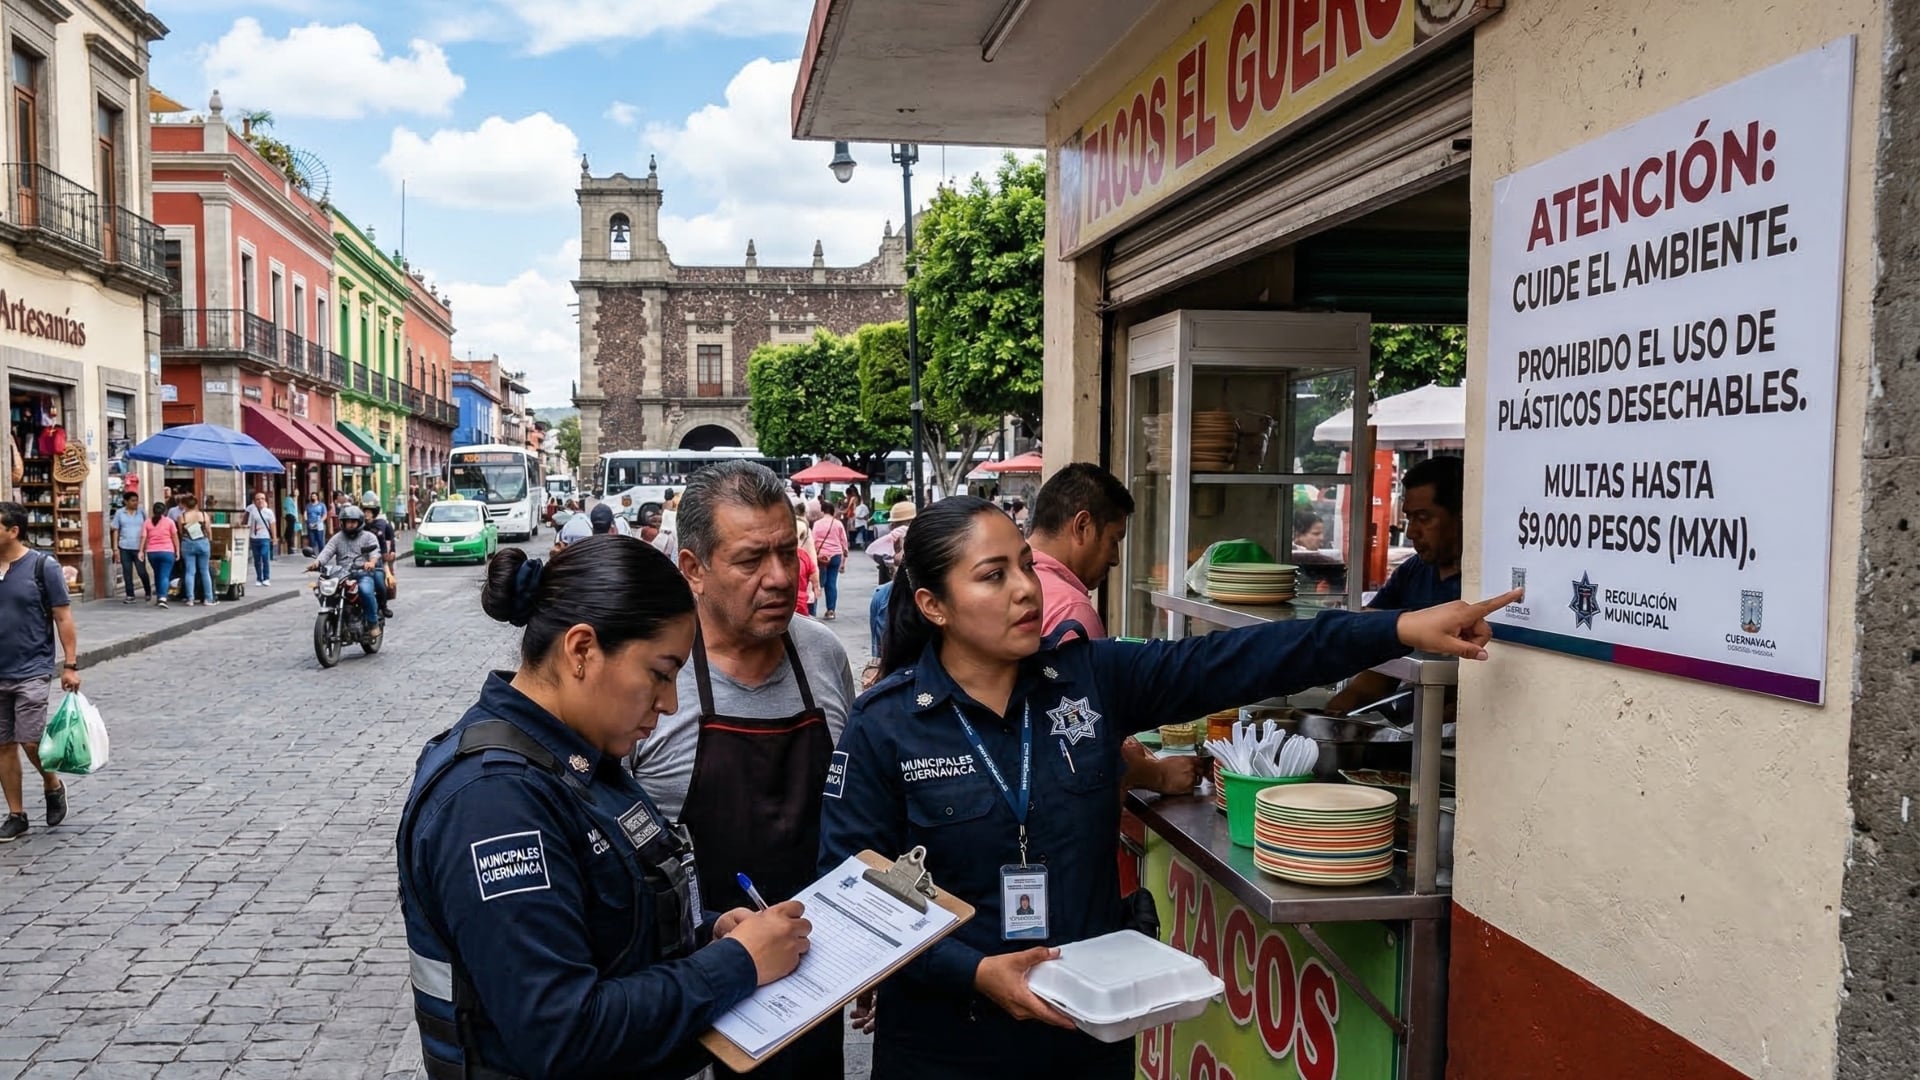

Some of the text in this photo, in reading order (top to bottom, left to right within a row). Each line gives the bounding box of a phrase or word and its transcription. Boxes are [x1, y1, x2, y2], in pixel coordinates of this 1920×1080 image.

[1085, 0, 1402, 224] TACOS EL GUER
[1526, 119, 1776, 251] ATENCIÓN:
[1513, 204, 1797, 313] CUIDE EL AMBIENTE.
[0, 288, 86, 346] Artesanías
[1518, 309, 1776, 383] PROHIBIDO EL USO DE
[1498, 369, 1806, 431] PLÁSTICOS DESECHABLES.
[1545, 460, 1714, 499] MULTAS HASTA
[1519, 507, 1756, 570] $9,000 PESOS (MXN).
[1605, 589, 1676, 611] REGULACIÓN
[1605, 607, 1669, 630] MUNICIPAL
[901, 755, 973, 771] MUNICIPALES
[904, 764, 976, 782] CUERNAVACA
[479, 847, 540, 871] MUNICIPALES
[482, 863, 542, 883] CUERNAVACA
[1169, 856, 1339, 1080] TACOS
